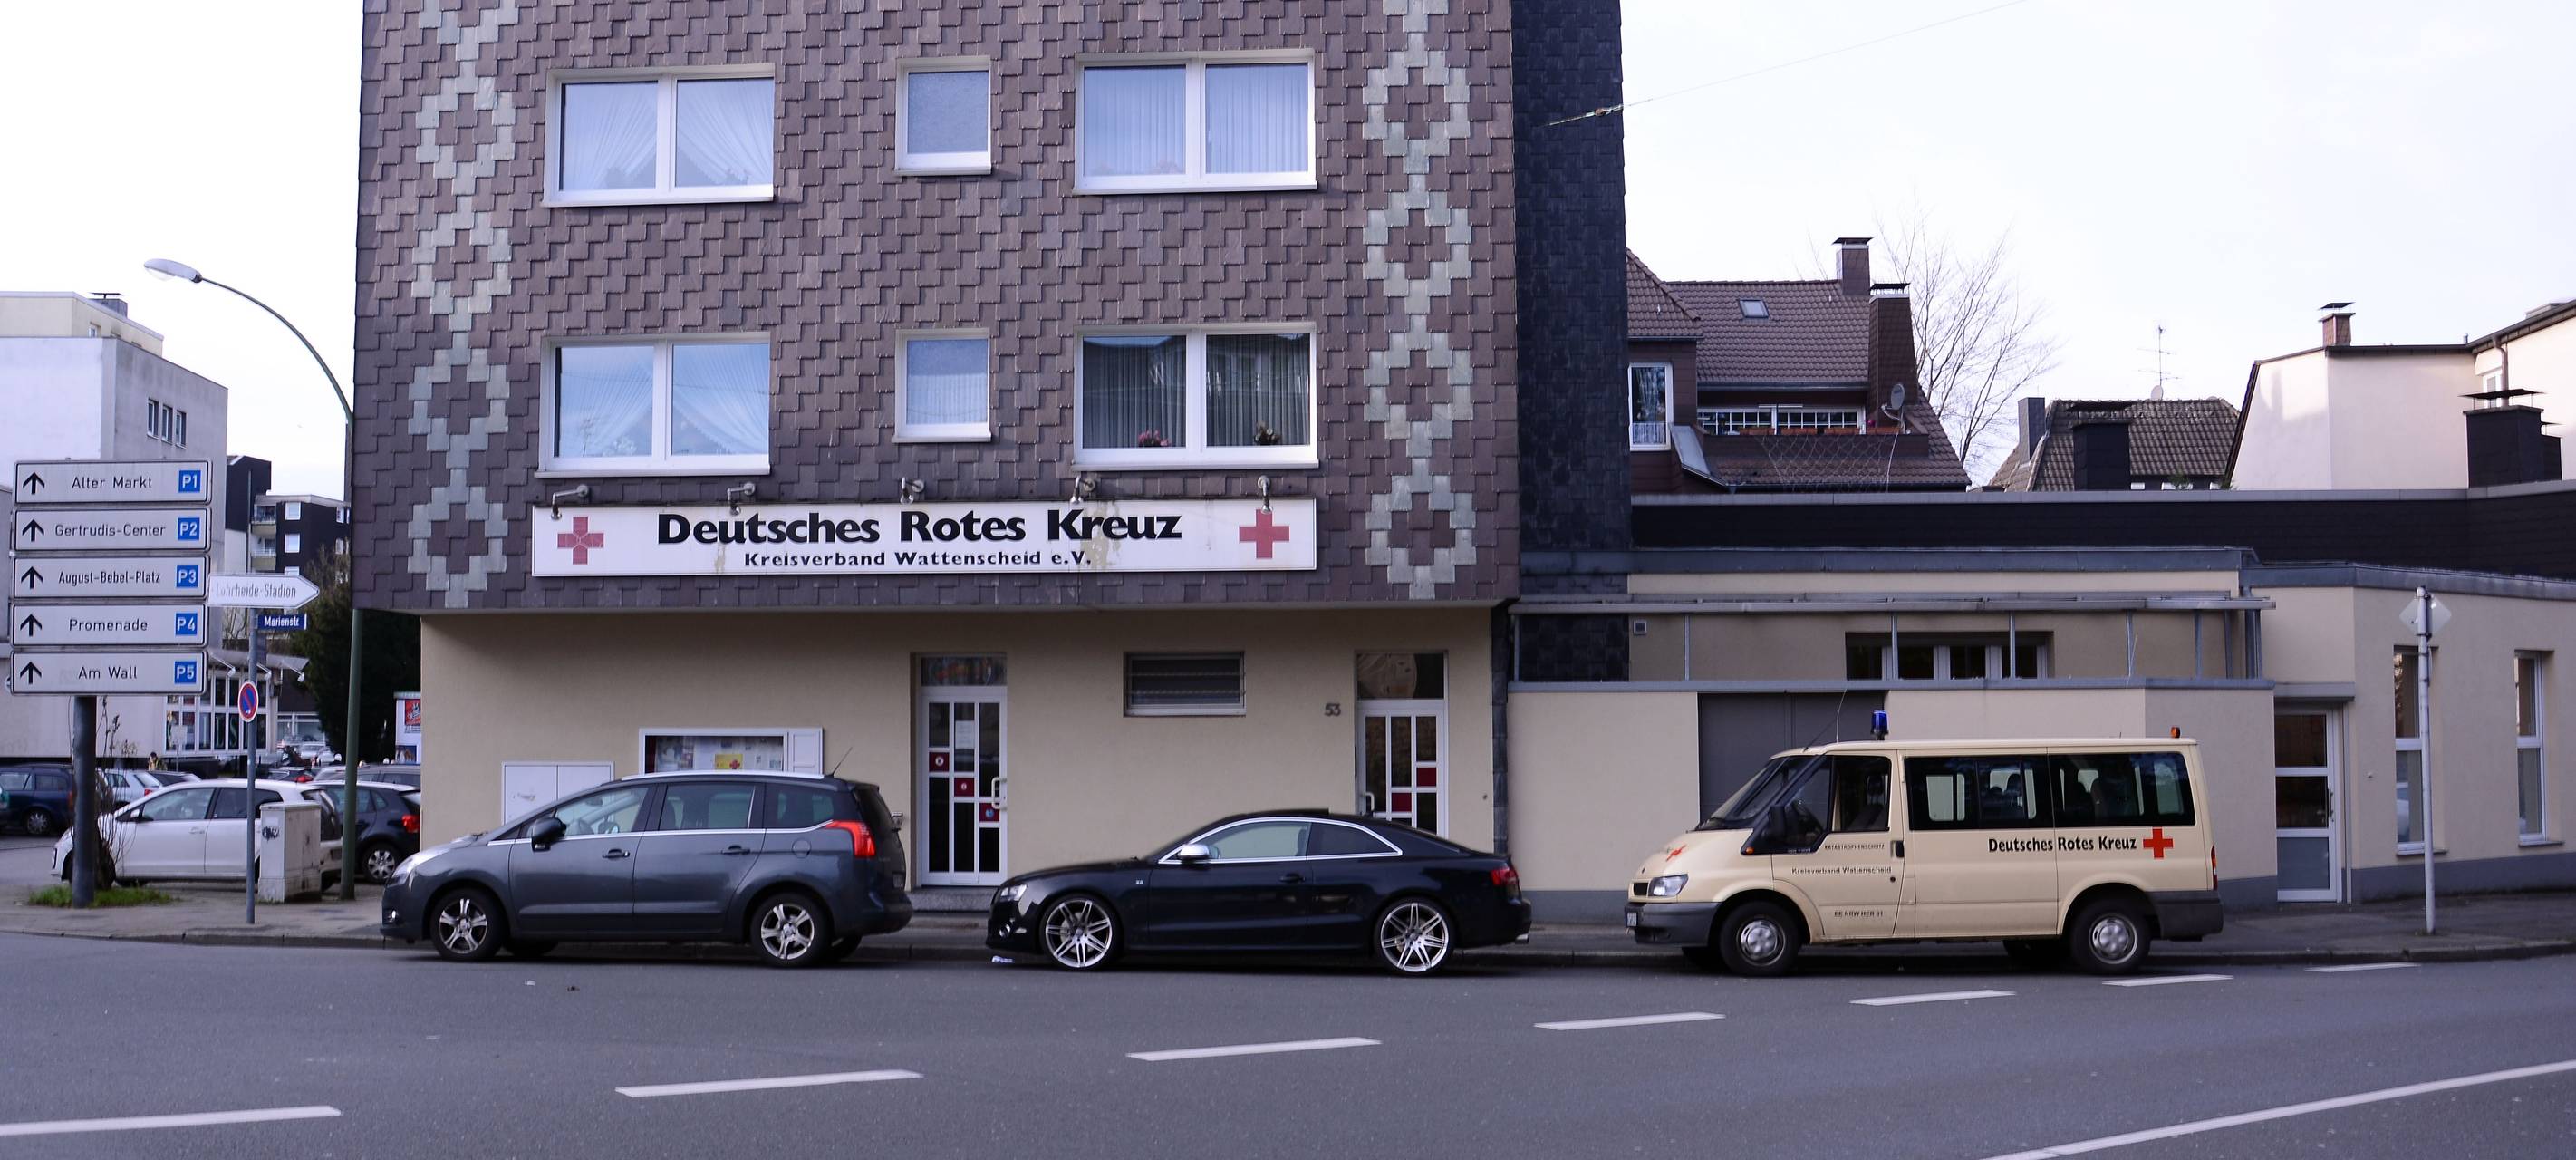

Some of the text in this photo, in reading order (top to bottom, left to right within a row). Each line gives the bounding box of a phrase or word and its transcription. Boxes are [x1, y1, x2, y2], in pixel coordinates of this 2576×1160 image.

[72, 476, 152, 489] Alter Markt
[182, 475, 198, 488] P1
[54, 524, 167, 536] Gertrudis-Center
[180, 522, 198, 536] P2
[658, 509, 1183, 546] Deutsches Rotes Kreuz
[744, 550, 1092, 567] Kreisverband Wattenscheid e.V.
[58, 570, 161, 587] August-Bebel-Platz
[178, 569, 197, 584] P3
[69, 619, 149, 632] Promenade
[177, 617, 196, 632] P4
[78, 666, 138, 680] Am Wall
[176, 665, 195, 680] P5
[1324, 702, 1341, 717] 53
[1988, 836, 2137, 853] Deutsches Rotes Kreuz
[1842, 866, 1892, 875] Wattenscheid
